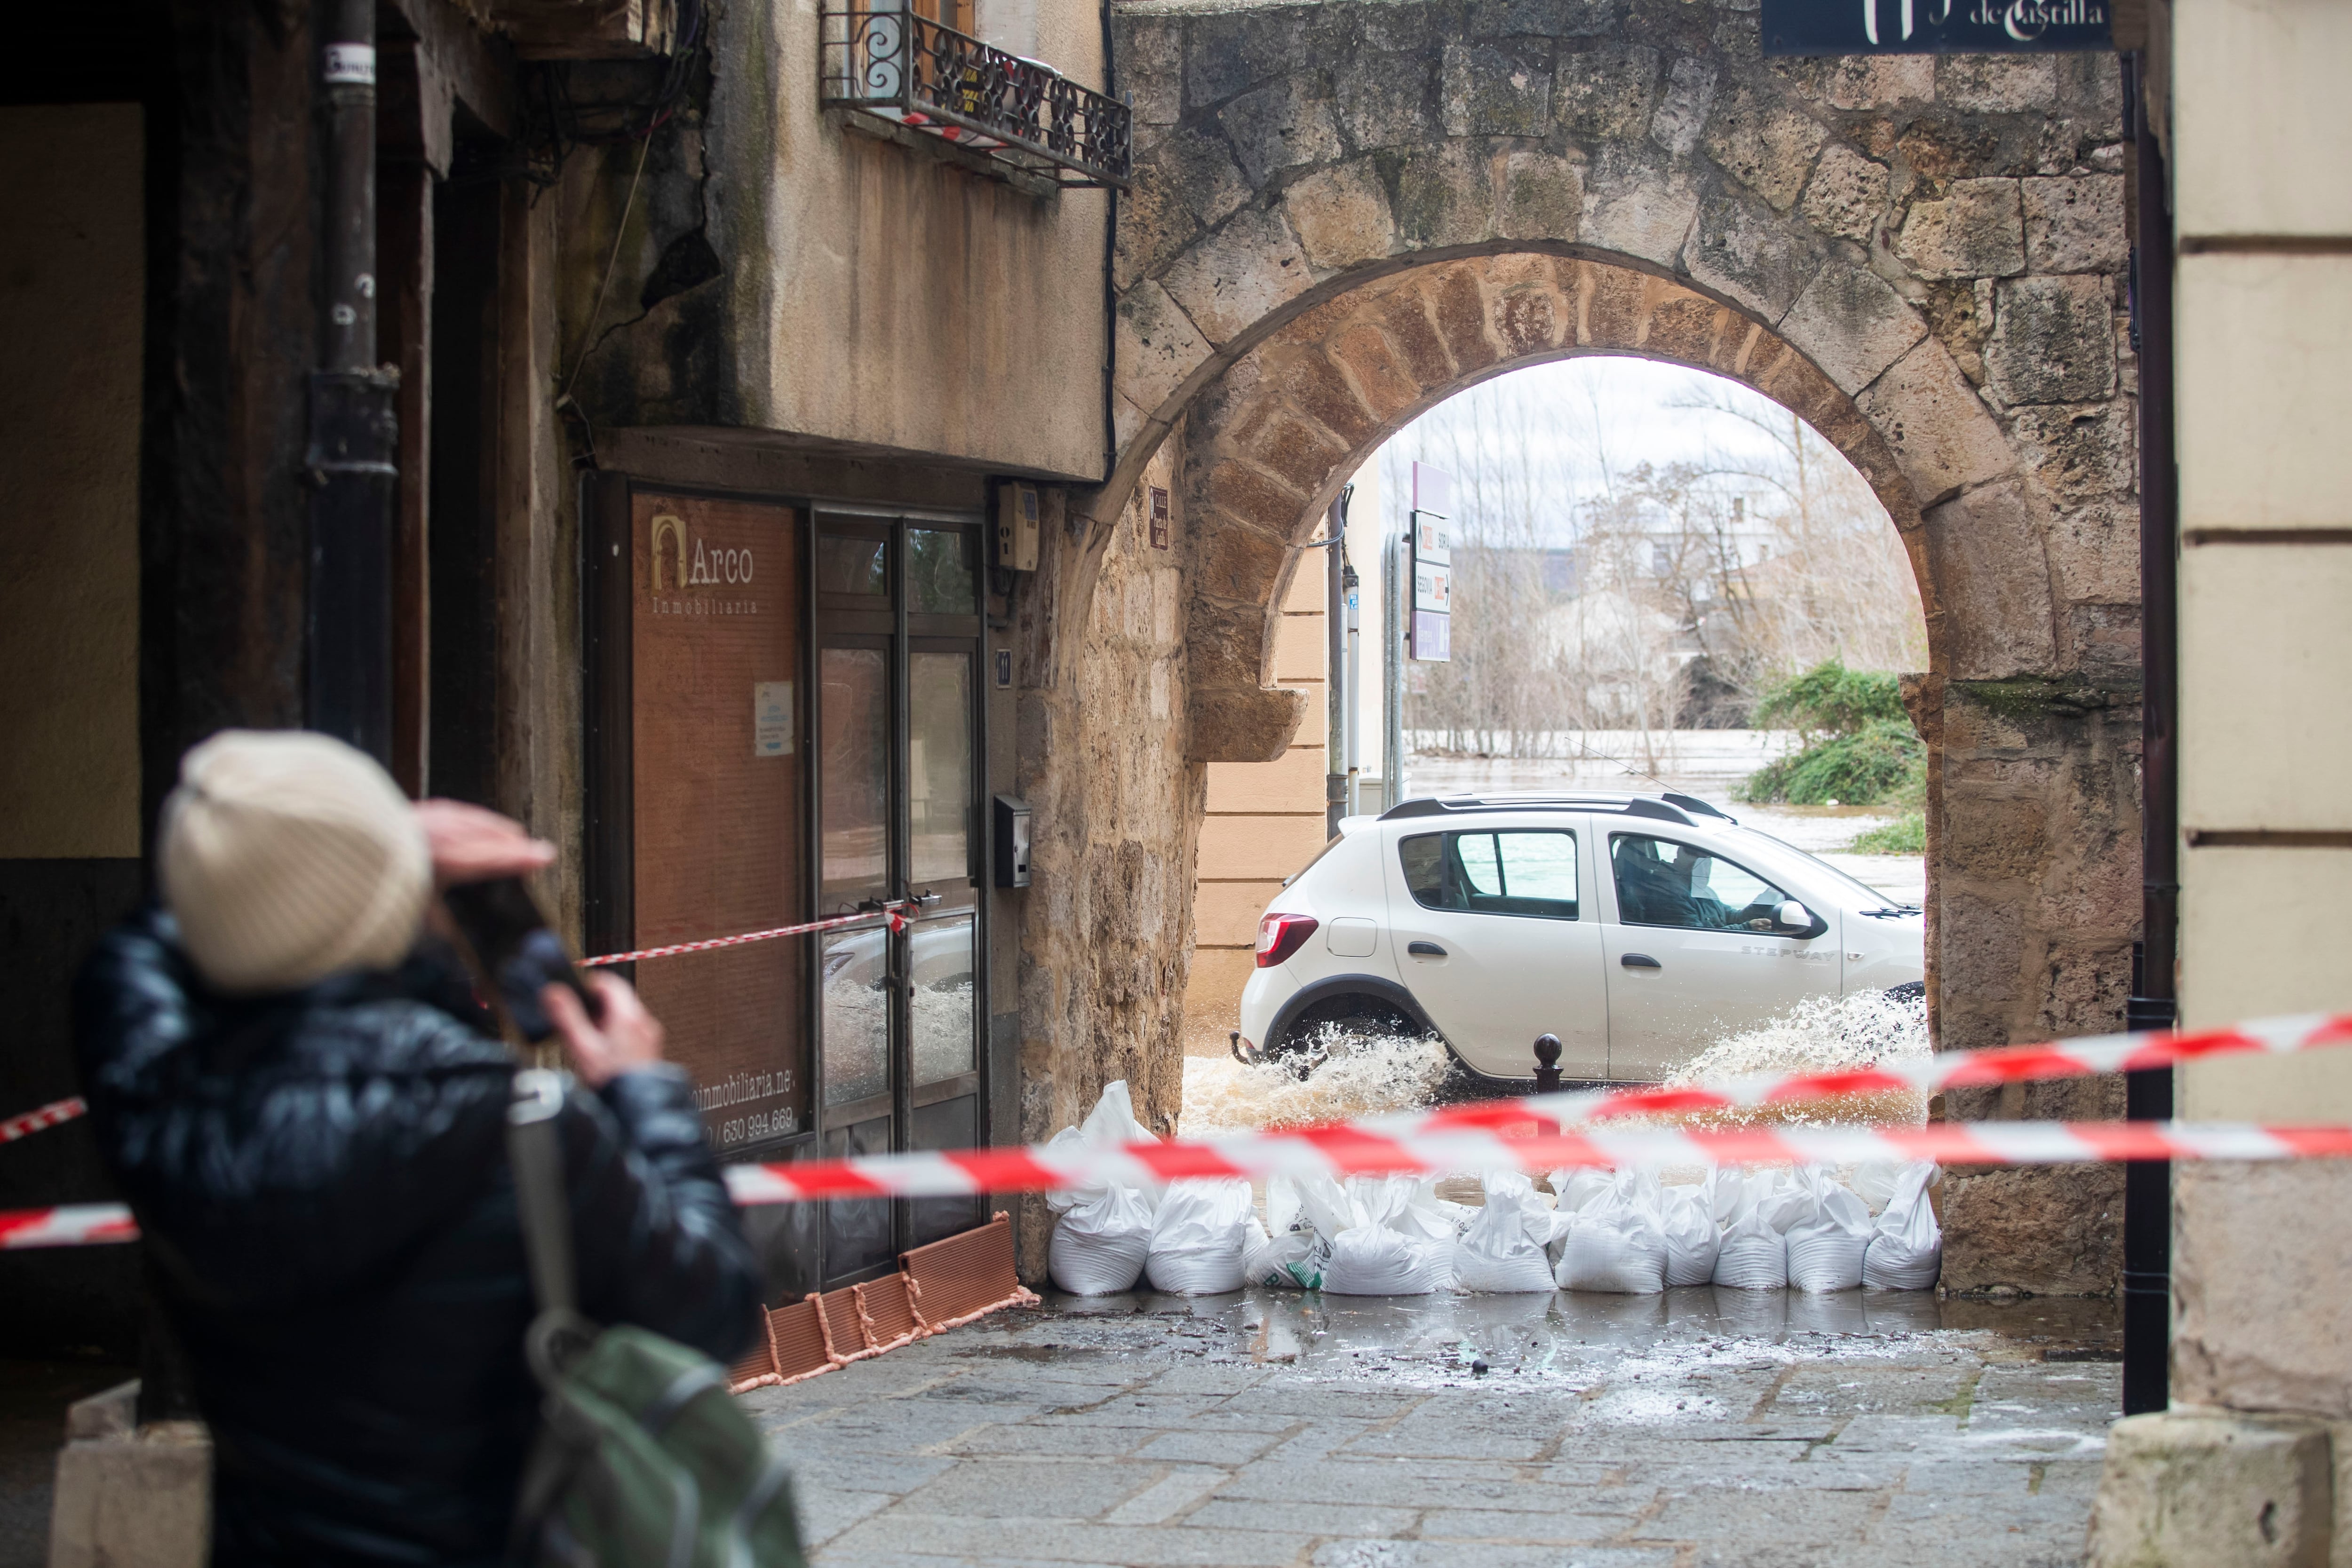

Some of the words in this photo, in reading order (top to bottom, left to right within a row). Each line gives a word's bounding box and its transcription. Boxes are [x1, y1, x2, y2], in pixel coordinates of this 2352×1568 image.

[1970, 0, 2002, 24] de
[2004, 0, 2104, 41] Castilla
[1155, 494, 1167, 508] CALLE
[1438, 532, 1449, 550] SORIA
[690, 538, 753, 584] Arco
[1417, 575, 1432, 595] SEGOVIA
[653, 597, 757, 614] Inmobiliaria
[1741, 945, 1835, 961] STEPWAY
[690, 1069, 796, 1113] oinmobiliaria.ne
[723, 1118, 745, 1143] 630
[747, 1114, 769, 1137] 994
[771, 1107, 793, 1131] 669
